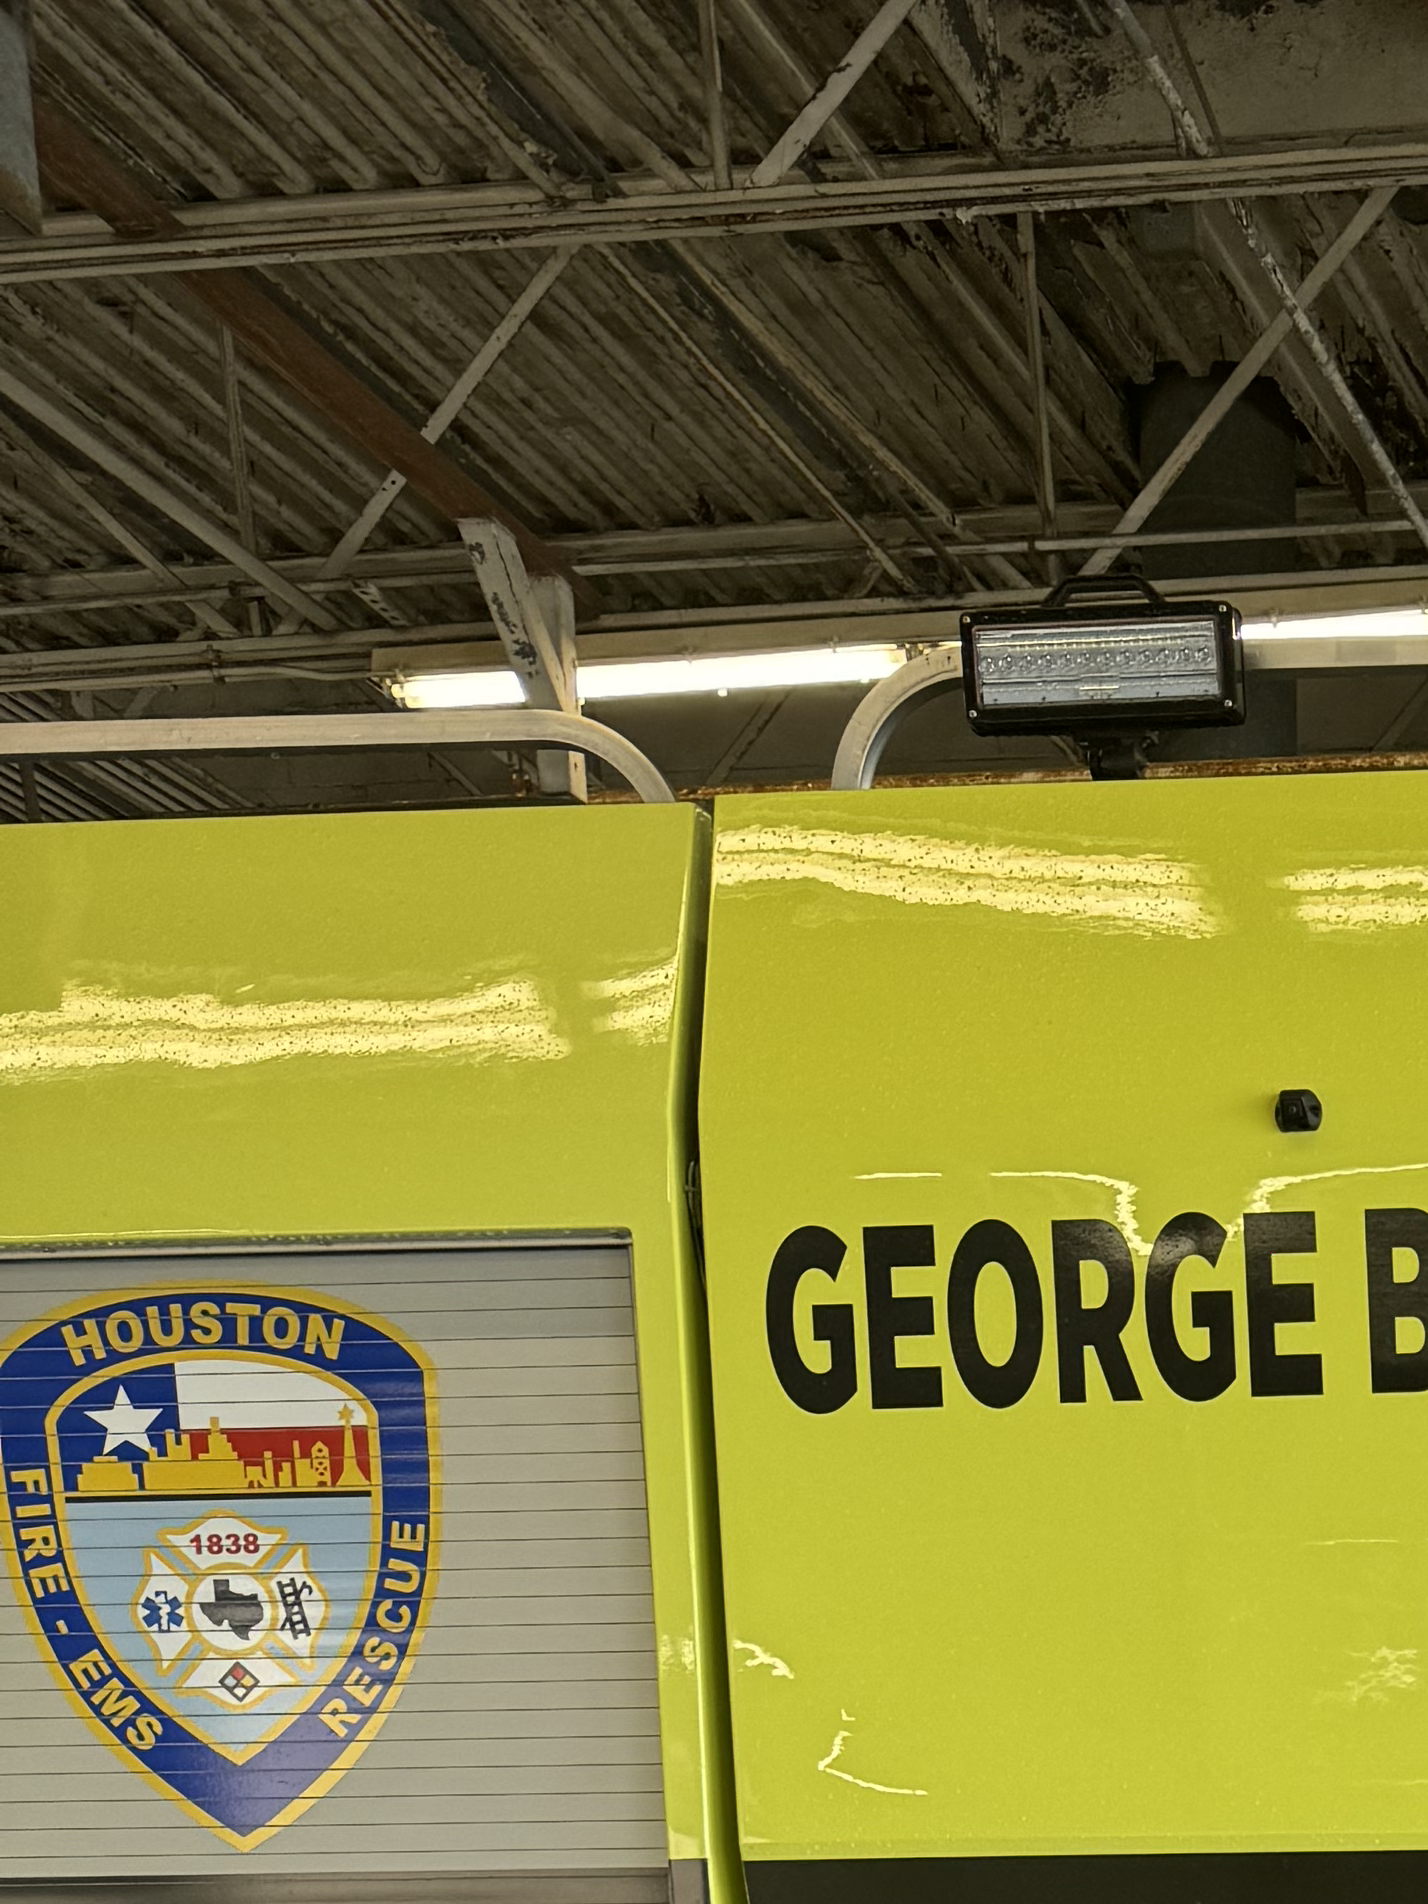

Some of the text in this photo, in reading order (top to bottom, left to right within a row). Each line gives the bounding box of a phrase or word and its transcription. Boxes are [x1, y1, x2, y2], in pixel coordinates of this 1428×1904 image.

[61, 1302, 345, 1366] HOUSTON
[765, 1210, 1324, 1414] GEORGE
[10, 1468, 69, 1600] FIRE
[68, 1650, 164, 1752] EMS
[189, 1533, 260, 1556] 1838
[317, 1521, 427, 1740] RESCUE
